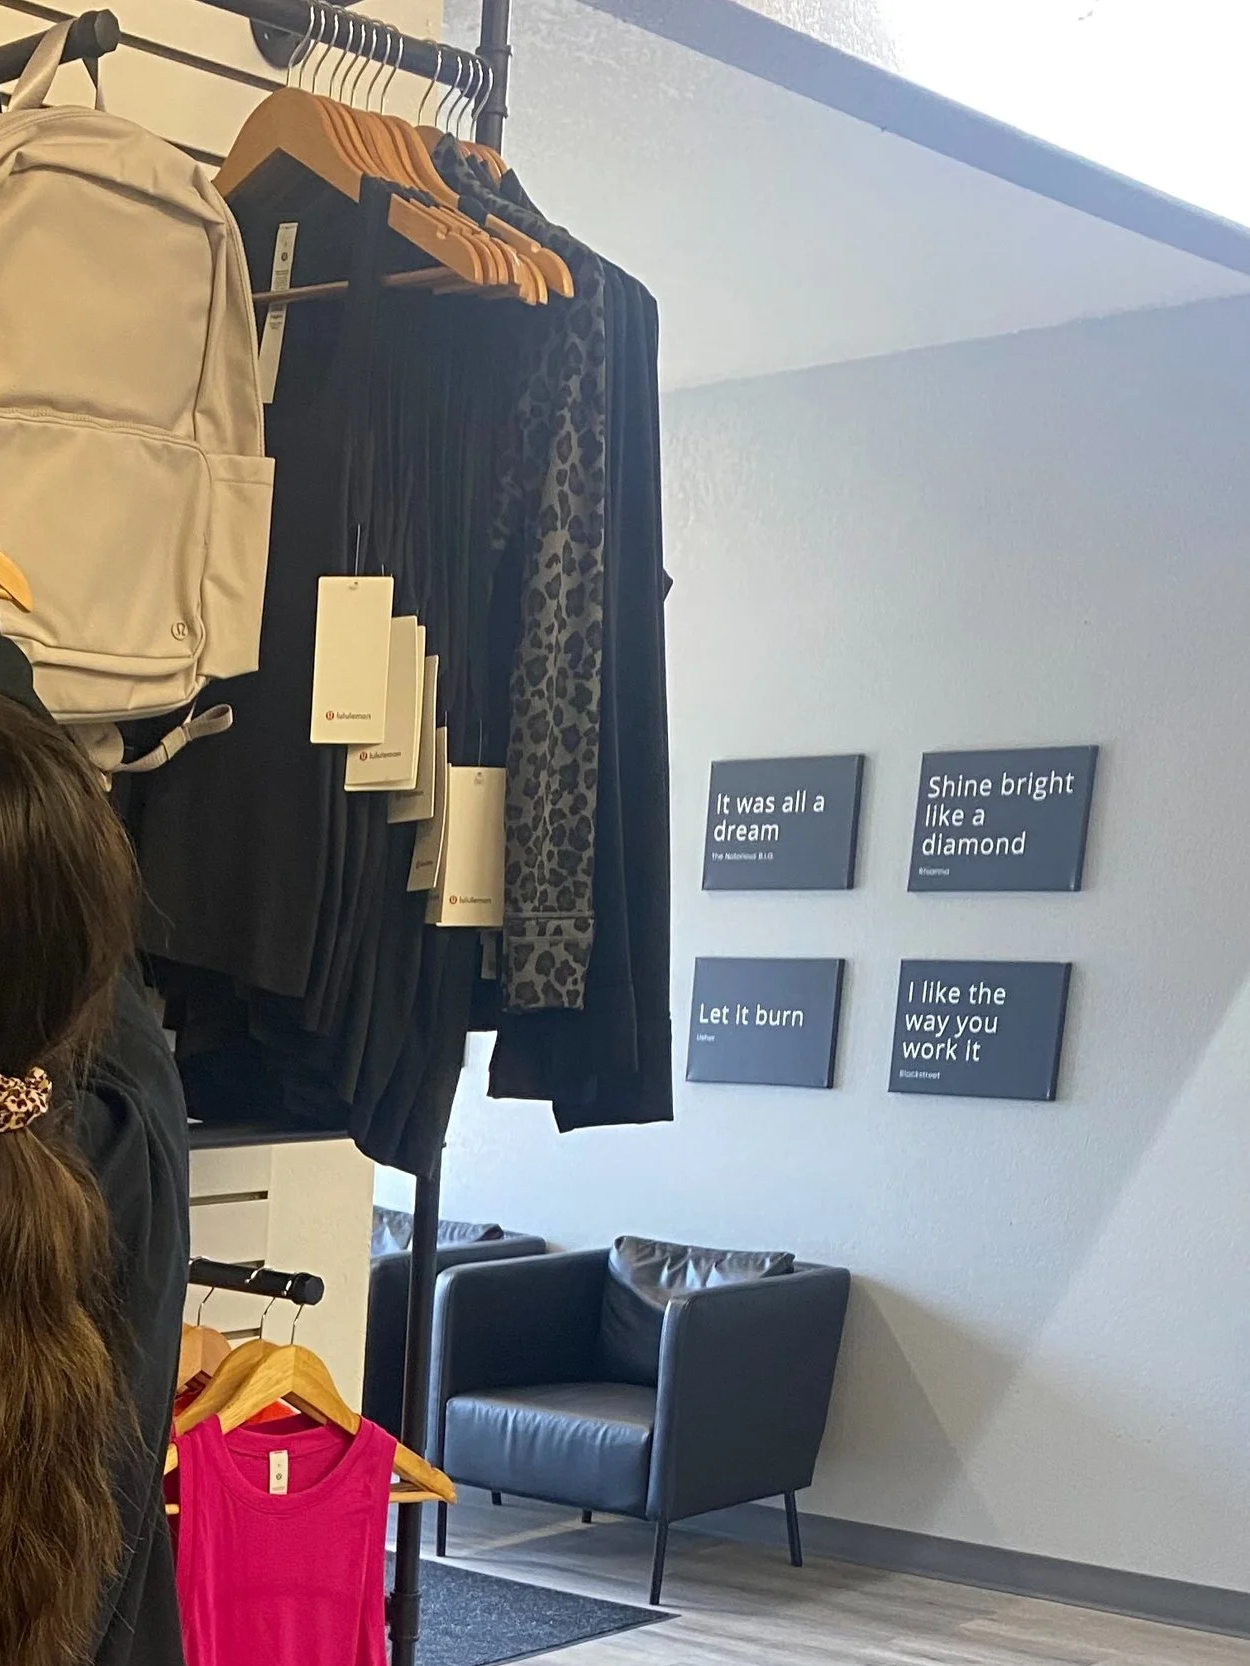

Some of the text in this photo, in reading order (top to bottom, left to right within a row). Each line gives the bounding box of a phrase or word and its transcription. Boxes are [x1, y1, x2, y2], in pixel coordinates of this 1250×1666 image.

[927, 770, 1075, 801] Shine bright
[716, 790, 825, 815] It was all a
[925, 803, 985, 828] like a
[713, 818, 779, 842] dream
[921, 831, 1026, 856] diamond
[908, 980, 1006, 1006] I like the
[699, 1003, 804, 1027] Let it burn
[905, 1014, 998, 1039] way you
[902, 1037, 981, 1062] work it
